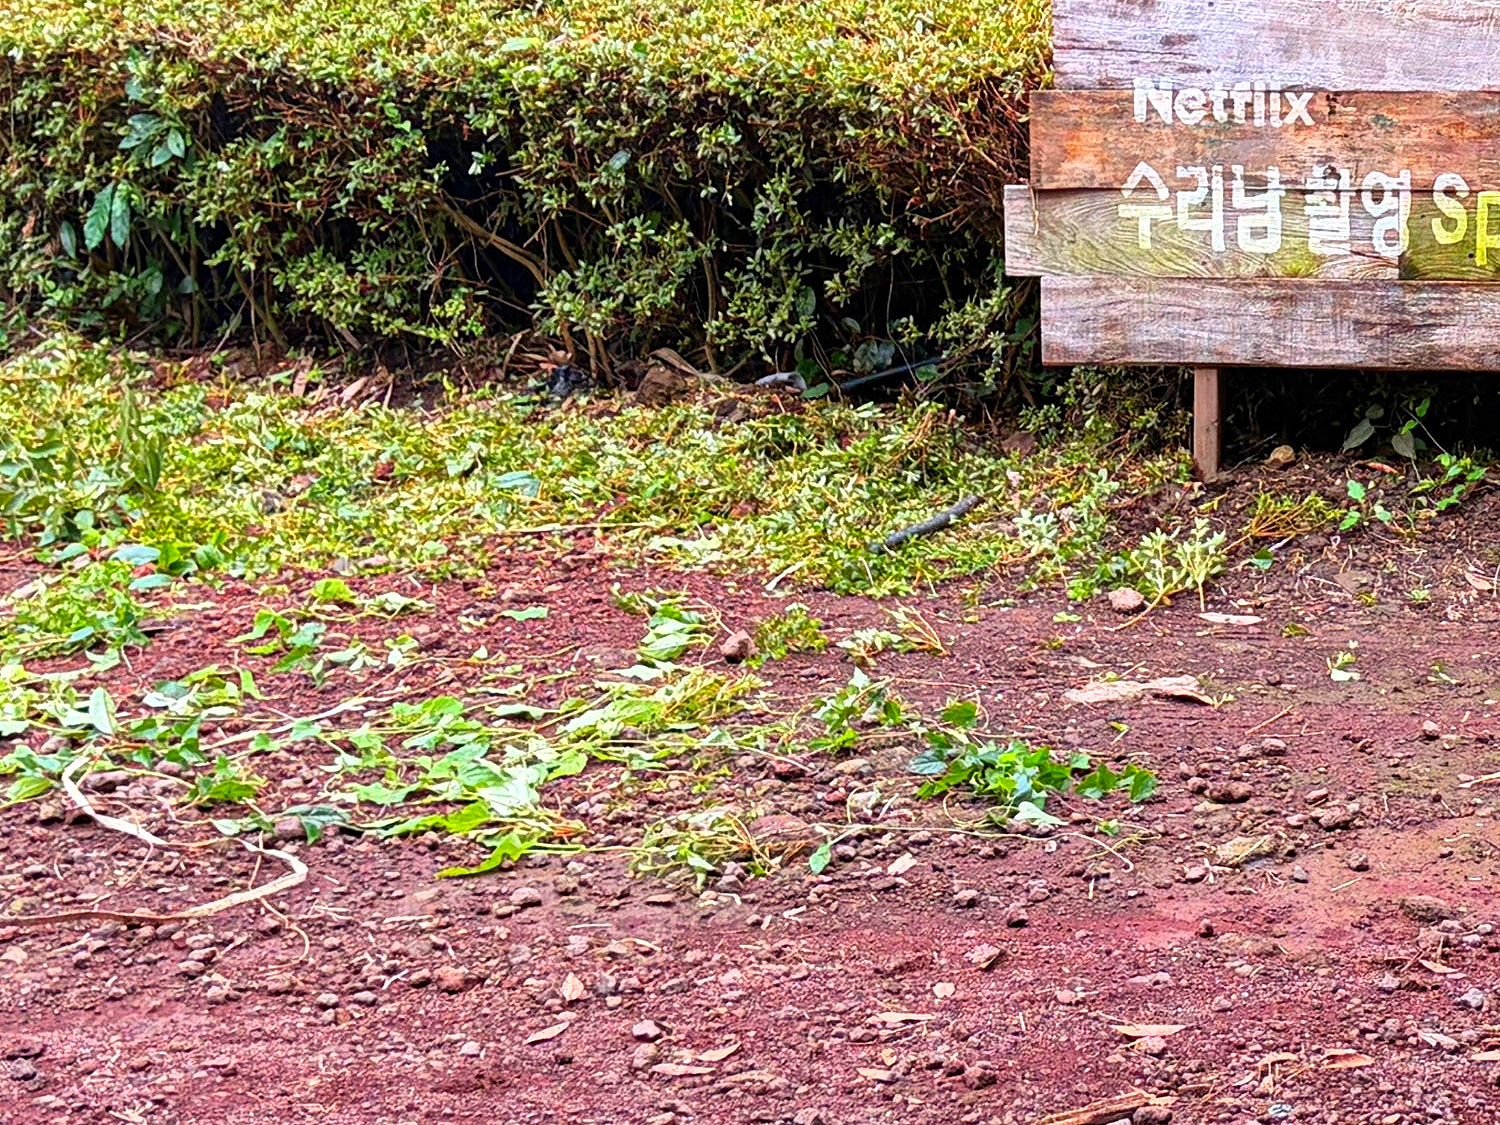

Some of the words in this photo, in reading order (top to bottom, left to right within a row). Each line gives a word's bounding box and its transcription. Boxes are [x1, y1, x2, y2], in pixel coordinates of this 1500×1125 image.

[1133, 77, 1315, 129] Netflix
[1118, 160, 1284, 254] 수리남
[1303, 164, 1412, 257] 촬영
